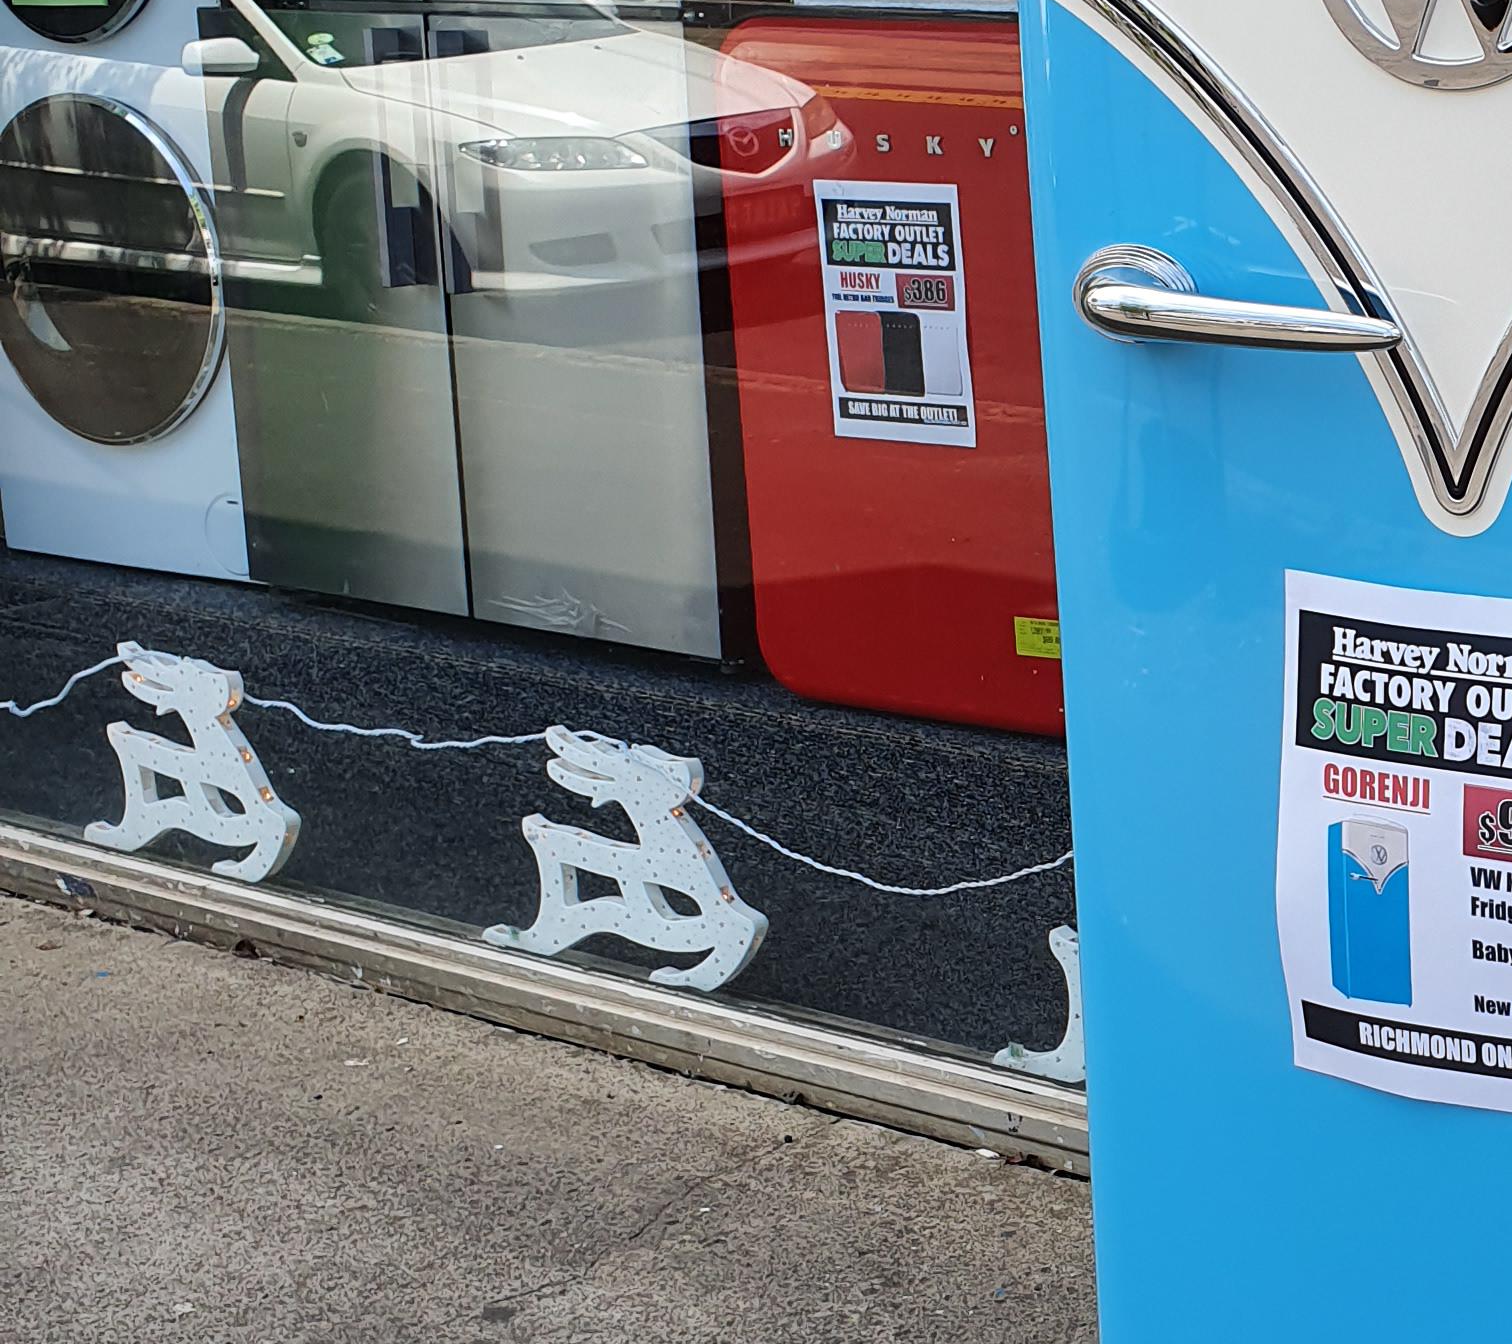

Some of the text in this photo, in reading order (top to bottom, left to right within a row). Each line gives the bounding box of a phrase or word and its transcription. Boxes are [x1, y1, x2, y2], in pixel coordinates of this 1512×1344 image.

[837, 204, 938, 223] Harvey Norman
[833, 222, 945, 243] FACTORY OUTLET
[832, 241, 950, 267] SUPER DEALS
[840, 271, 947, 304] HUSKY $386
[848, 401, 870, 416] SAVE
[890, 402, 900, 417] AT
[902, 403, 919, 419] THE
[1332, 626, 1440, 672] Harvey
[1321, 663, 1455, 713] FACTORY
[1311, 697, 1439, 757] SUPER
[1323, 763, 1430, 809] GORENJI
[1470, 866, 1502, 891] VW
[1474, 995, 1511, 1017] New
[1358, 1021, 1476, 1064] RICHMOND
